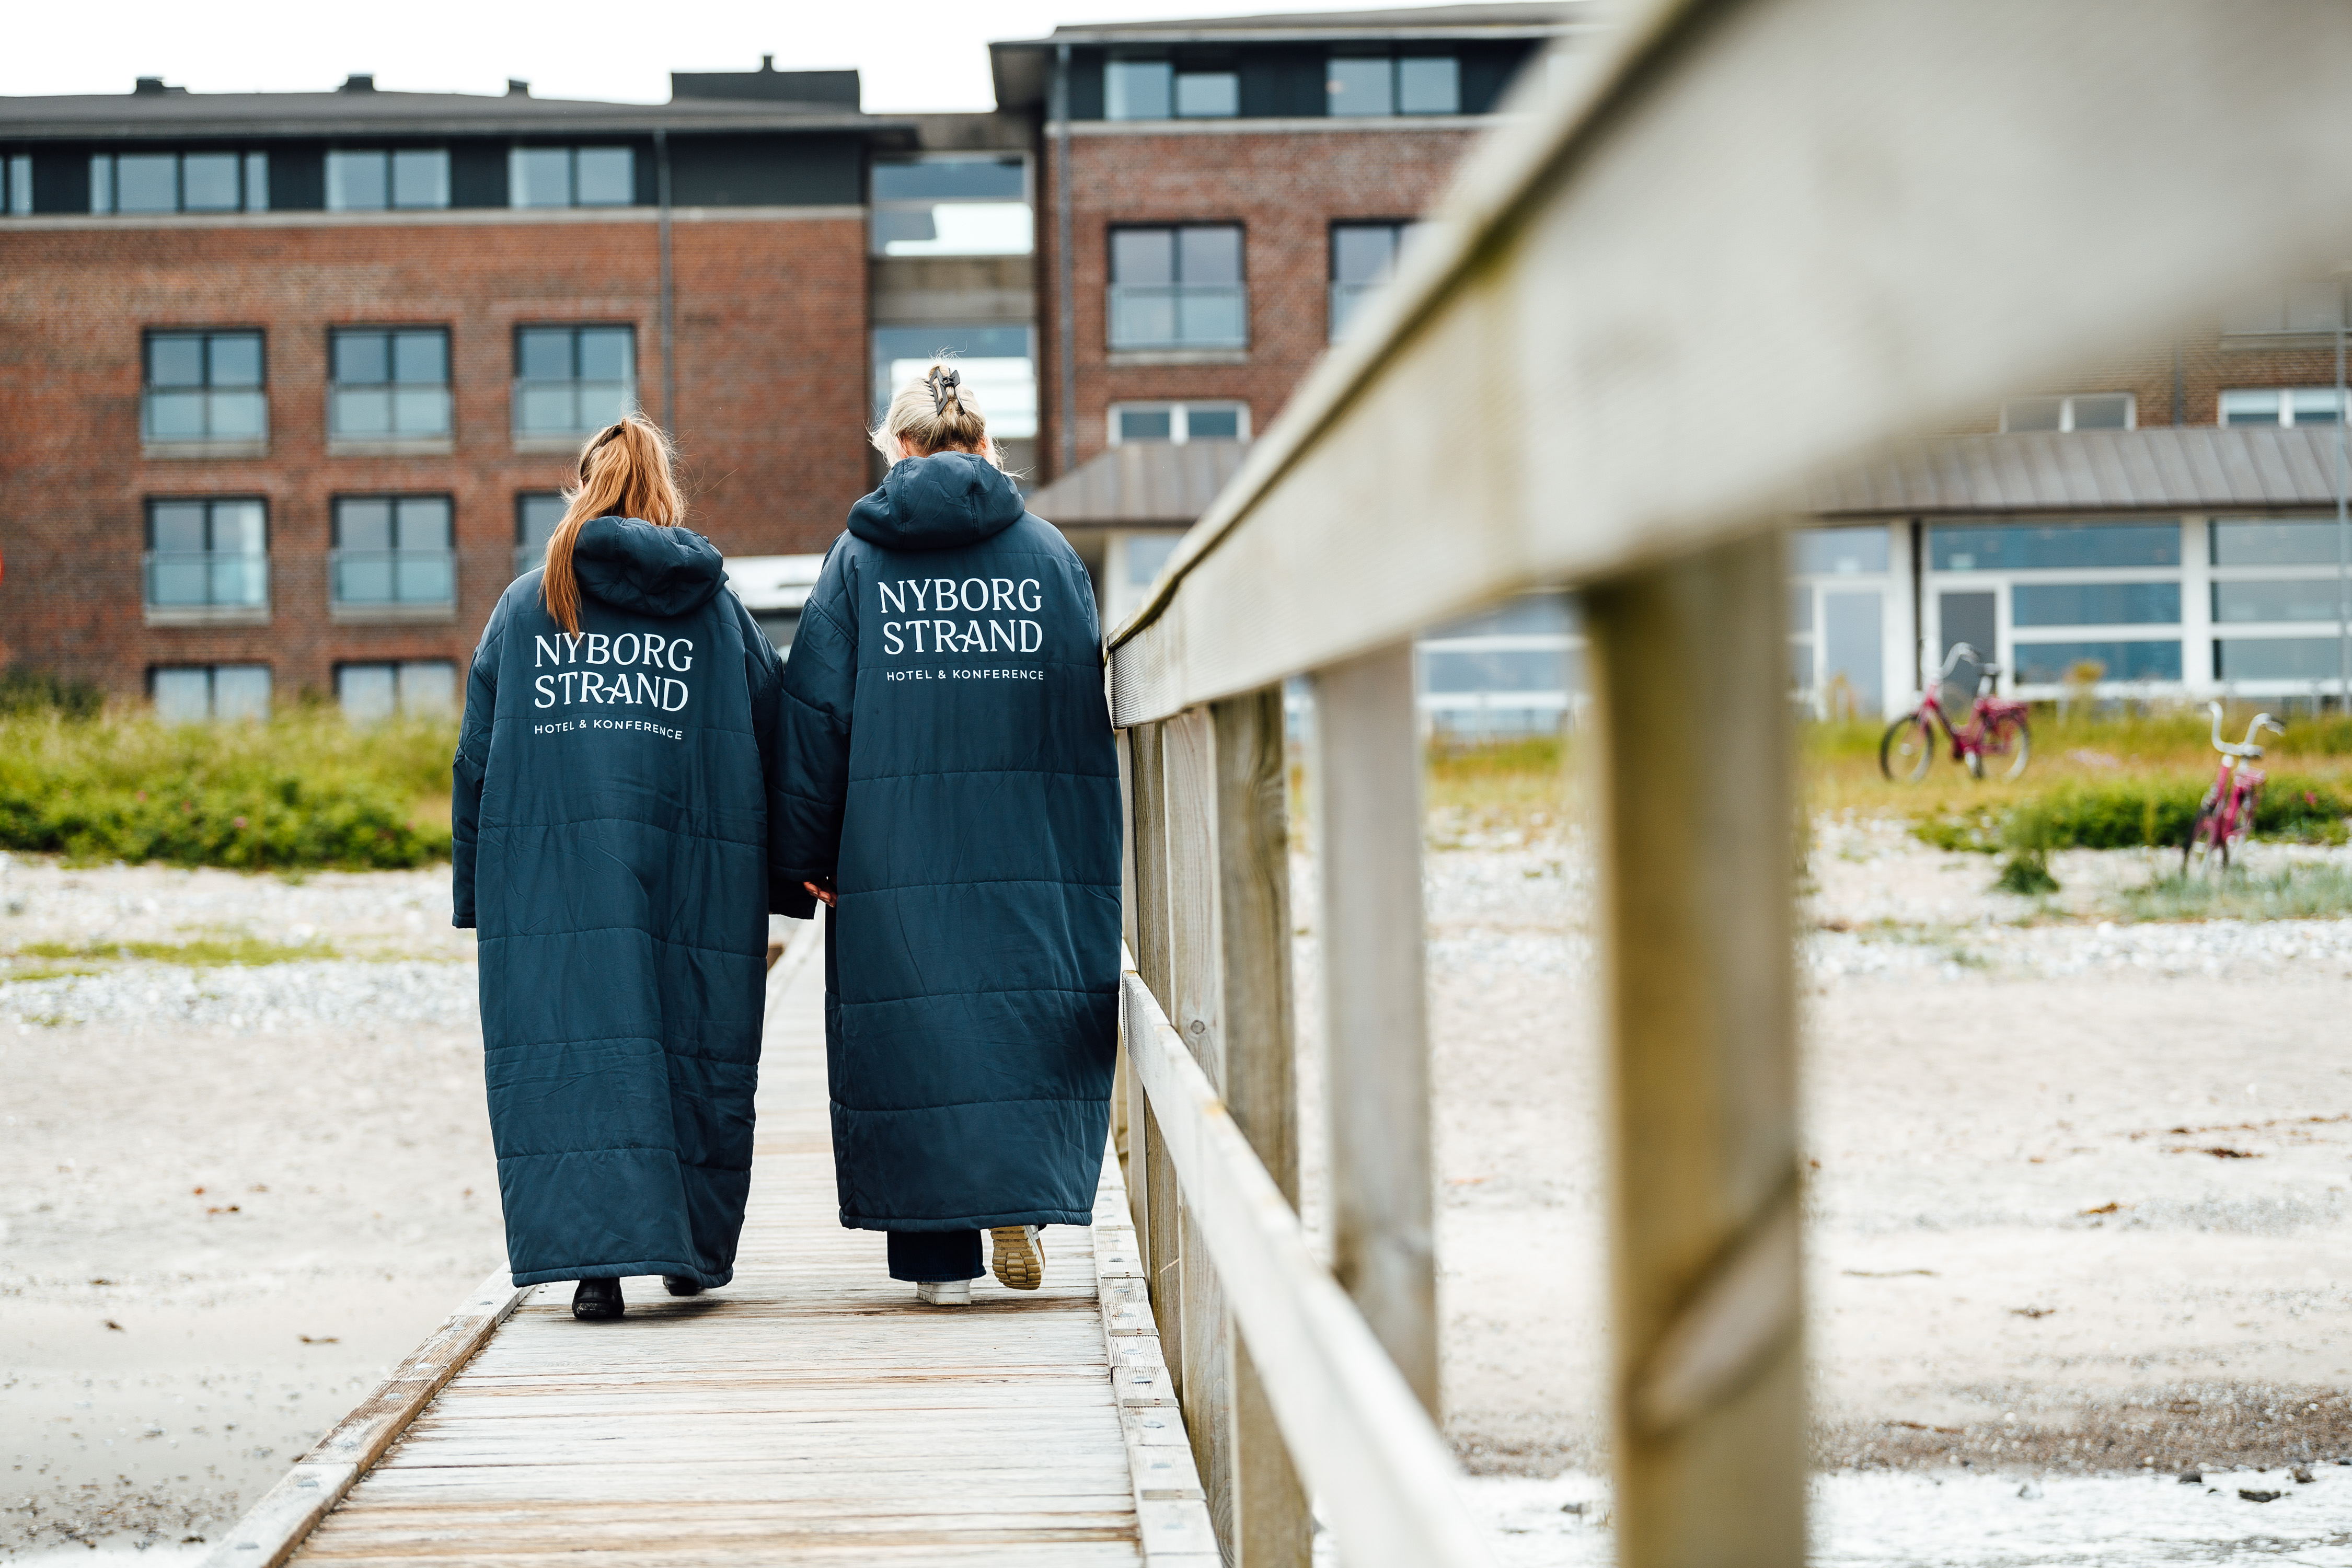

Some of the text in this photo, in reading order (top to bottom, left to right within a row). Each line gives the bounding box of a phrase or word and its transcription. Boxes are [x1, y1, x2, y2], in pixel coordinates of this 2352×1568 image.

[878, 578, 1042, 614] NYBORG
[535, 632, 693, 672] NYBORG
[883, 620, 1043, 655] STRAND
[535, 671, 688, 711] STRAND
[886, 670, 1044, 682] HOTEL & KONFERENCE
[535, 719, 683, 740] HOTEL & KONFERENCE
